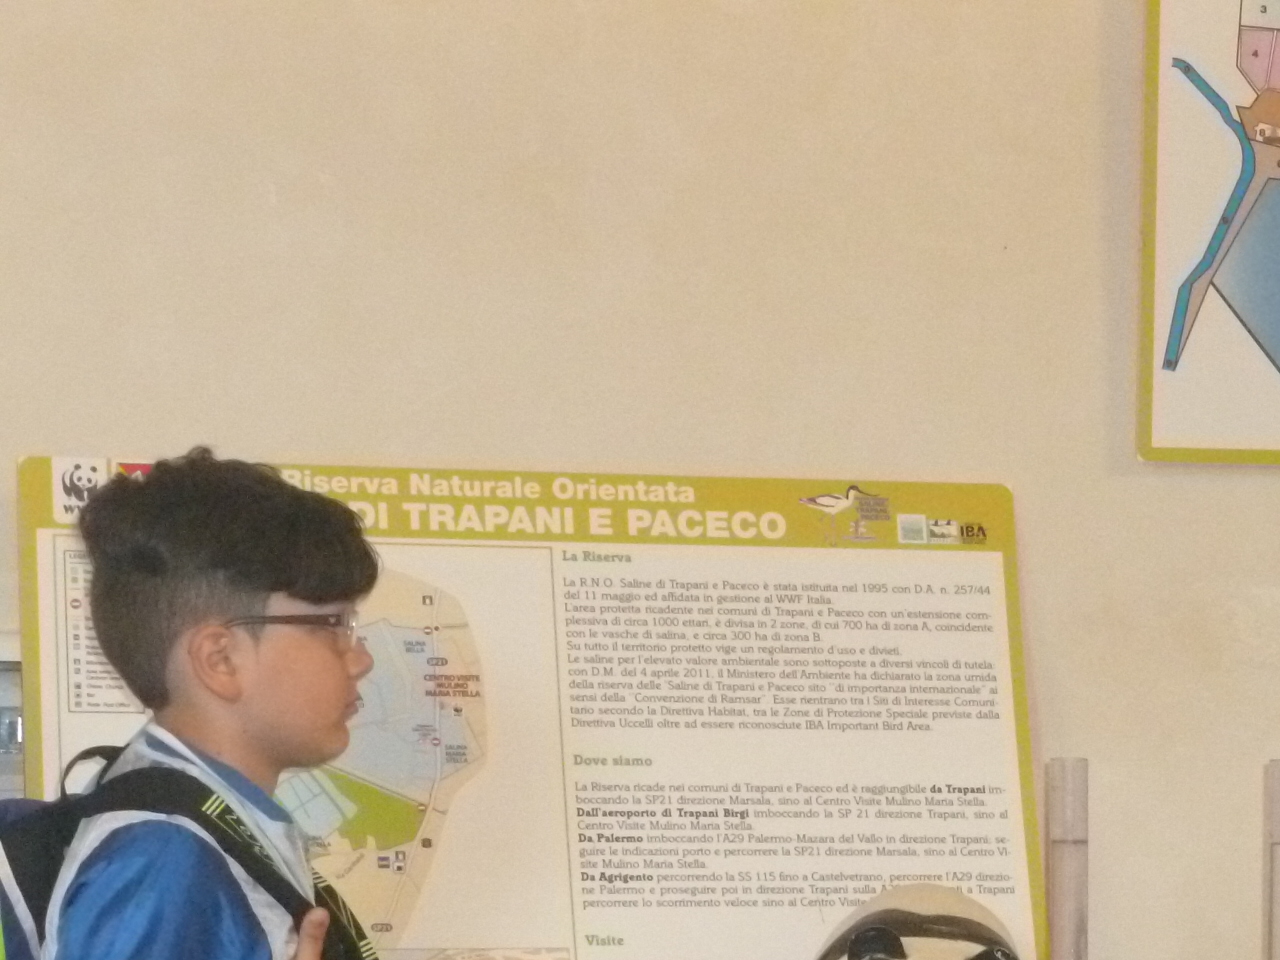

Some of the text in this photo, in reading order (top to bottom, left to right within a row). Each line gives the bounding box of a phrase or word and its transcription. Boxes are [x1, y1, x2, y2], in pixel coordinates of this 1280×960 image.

[1260, 5, 1267, 14] 3
[1252, 50, 1259, 58] 4
[280, 469, 695, 503] Riserva Naturale Orientata
[403, 503, 574, 534] TRAPANI
[589, 508, 614, 536] E
[628, 508, 786, 539] PACECO
[562, 552, 633, 563] La Riserva
[563, 577, 577, 588] La
[619, 578, 653, 589] Saline
[655, 579, 667, 589] di
[669, 579, 710, 592] Trapani
[722, 580, 760, 591] Paceco
[763, 581, 770, 591] è
[773, 581, 798, 592] stata
[841, 582, 859, 593] nel
[862, 583, 889, 594] 1995
[891, 586, 912, 594] con
[563, 590, 581, 600] del
[585, 590, 597, 601] 11
[600, 590, 642, 604] maggio
[644, 591, 659, 602] ed
[703, 592, 714, 603] in
[716, 593, 761, 606] gestione
[763, 594, 775, 604] al
[775, 594, 804, 605] WWF
[571, 717, 616, 728] Direttiva
[619, 718, 654, 728] Uccelli
[657, 718, 681, 729] oltre
[684, 718, 698, 729] ad
[700, 721, 736, 729] essere
[738, 719, 803, 730] riconosciute
[805, 720, 825, 730] IBA
[827, 720, 880, 734] Important
[881, 721, 905, 731] Bird
[573, 756, 653, 767] Dove siamo
[661, 808, 673, 818] di
[677, 808, 719, 821] Trapani
[723, 808, 750, 821] Birgi
[753, 808, 820, 819] imboccando
[824, 808, 834, 819] la
[838, 808, 852, 819] SP
[857, 809, 869, 819] 21
[875, 809, 923, 819] direzione
[974, 809, 996, 820] sino
[999, 809, 1009, 820] al
[577, 820, 615, 831] Centro
[617, 821, 647, 831] Visite
[649, 821, 688, 831] Mulino
[689, 821, 721, 831] Maria
[578, 833, 644, 843] Da Palermo
[580, 872, 655, 884] Da Agrigento
[585, 936, 625, 946] Visite
